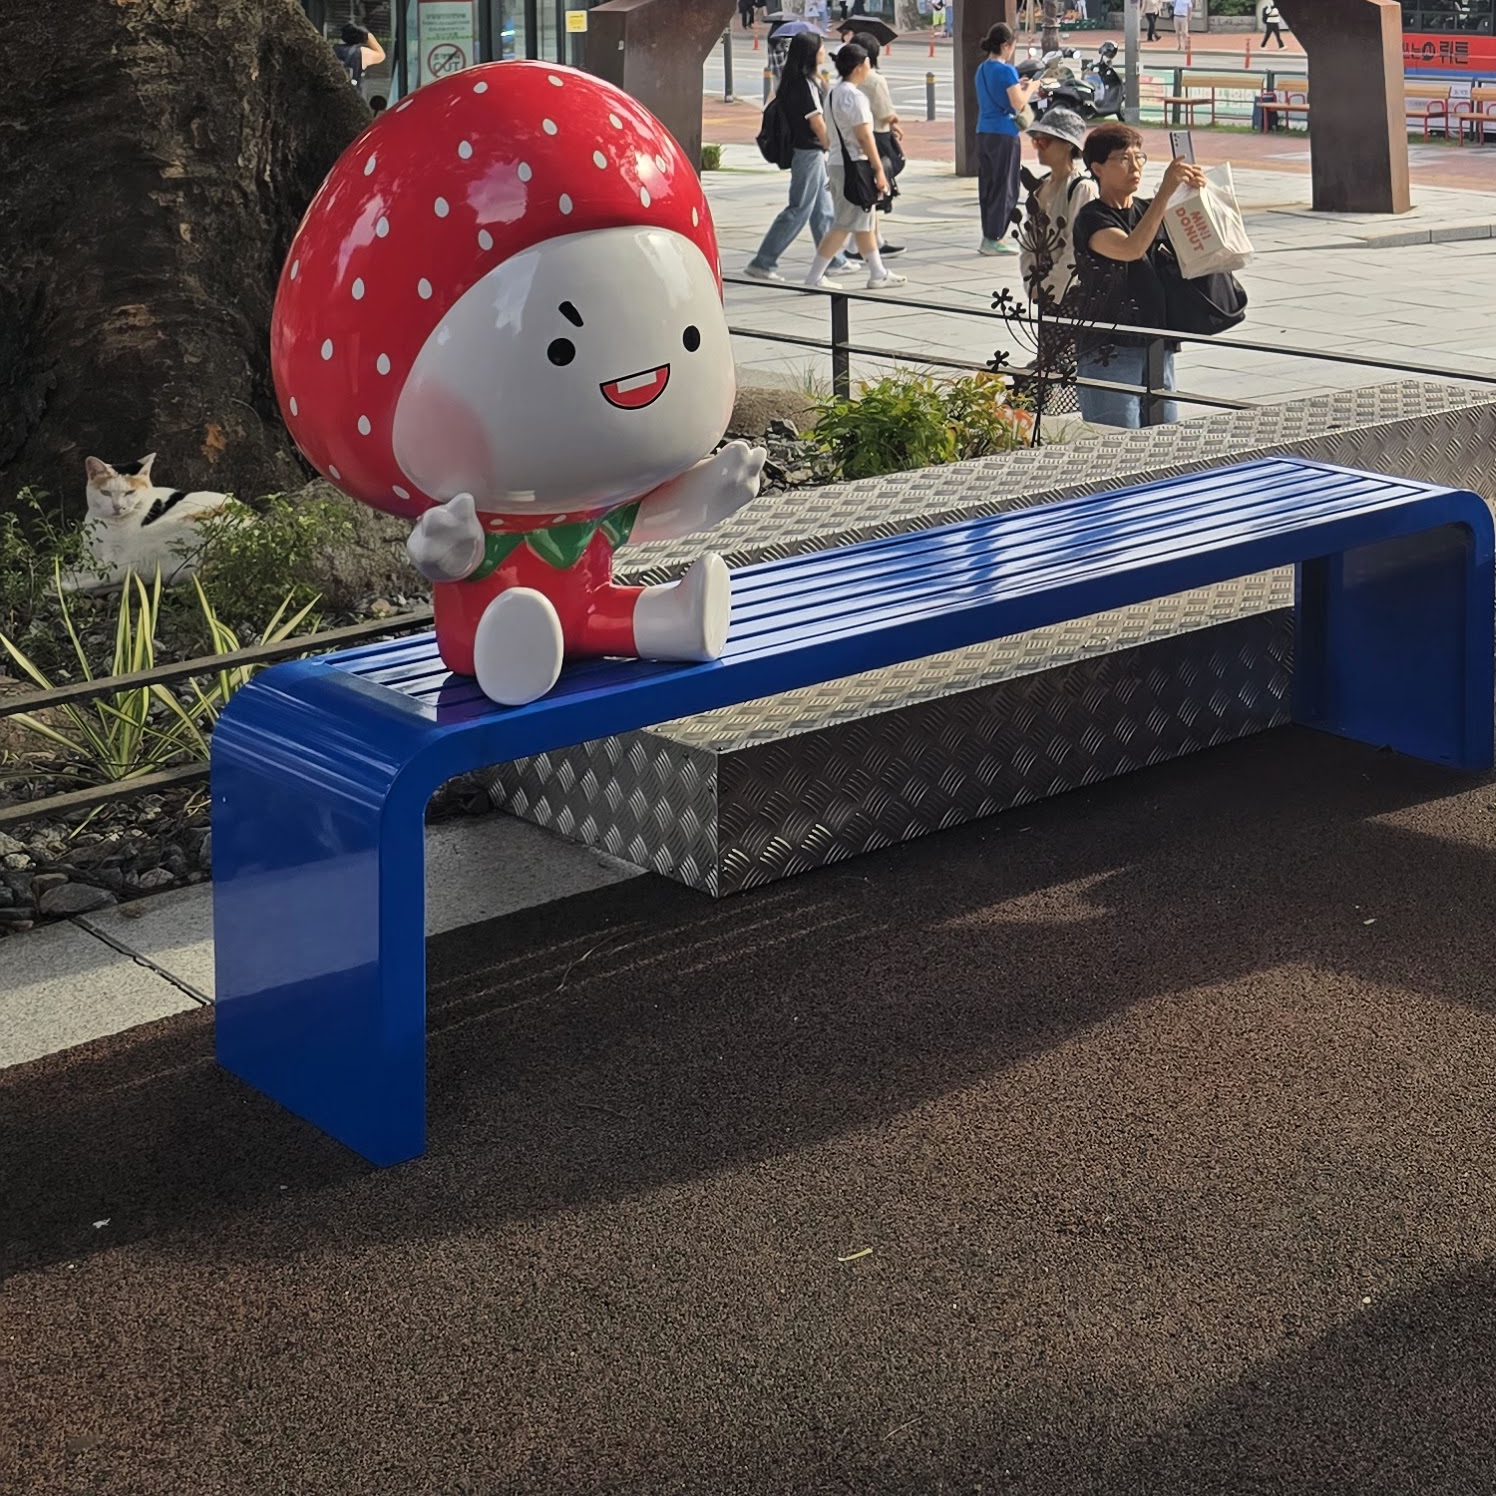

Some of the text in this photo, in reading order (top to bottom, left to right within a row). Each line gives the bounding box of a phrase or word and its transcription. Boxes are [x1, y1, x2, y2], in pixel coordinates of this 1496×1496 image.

[1439, 41, 1469, 65] 뤼튼
[1175, 206, 1205, 251] DONUT
[1190, 209, 1212, 240] MINI
